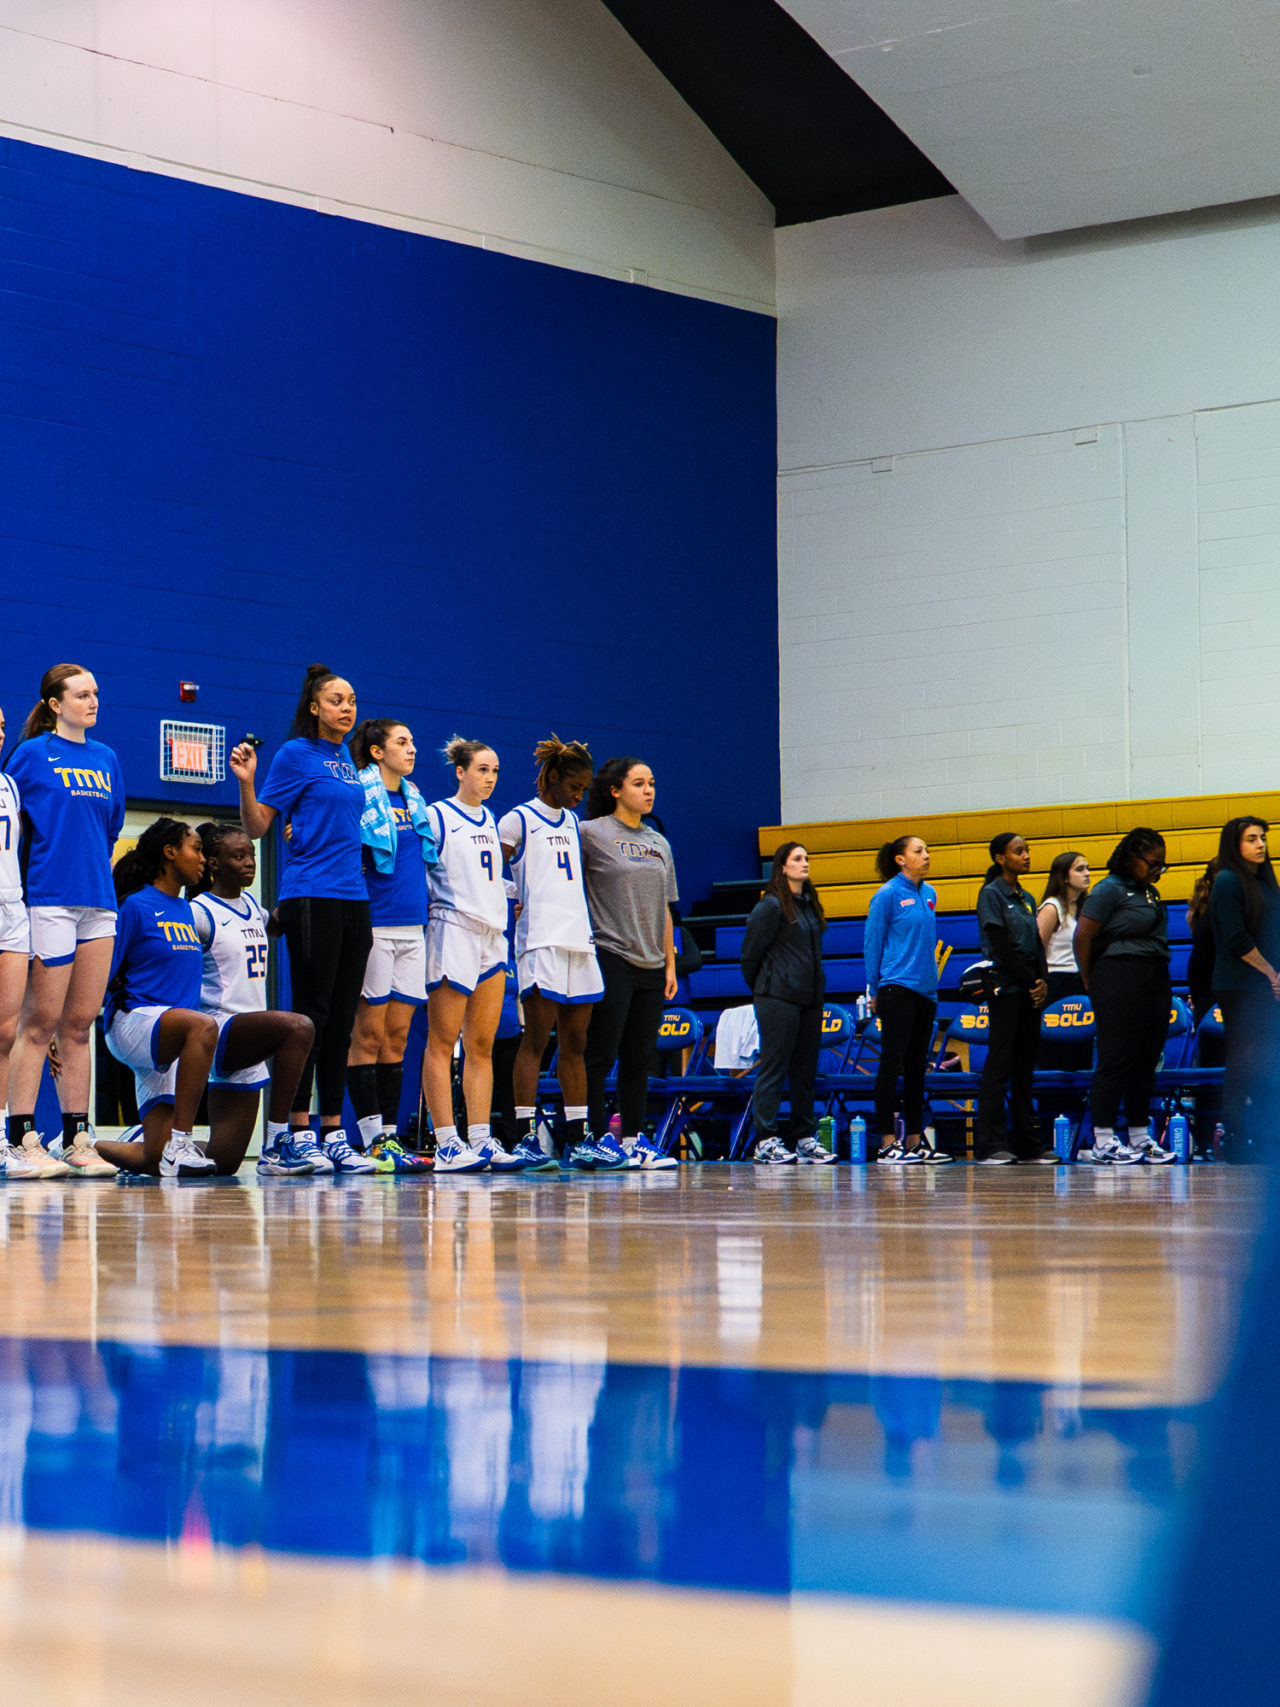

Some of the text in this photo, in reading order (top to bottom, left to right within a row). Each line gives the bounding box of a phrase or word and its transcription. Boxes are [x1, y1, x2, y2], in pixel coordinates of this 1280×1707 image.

[177, 743, 203, 770] EXIT
[54, 767, 112, 793] TMU
[71, 789, 109, 800] BASKETBALL
[470, 835, 494, 845] TMU
[547, 836, 570, 846] TMU
[481, 850, 494, 881] 9
[557, 851, 574, 881] 4
[240, 928, 264, 939] TMU
[245, 944, 267, 979] 25
[1062, 1003, 1082, 1011] TMU
[1043, 1011, 1095, 1027] BOLD
[658, 1022, 690, 1036] OLD
